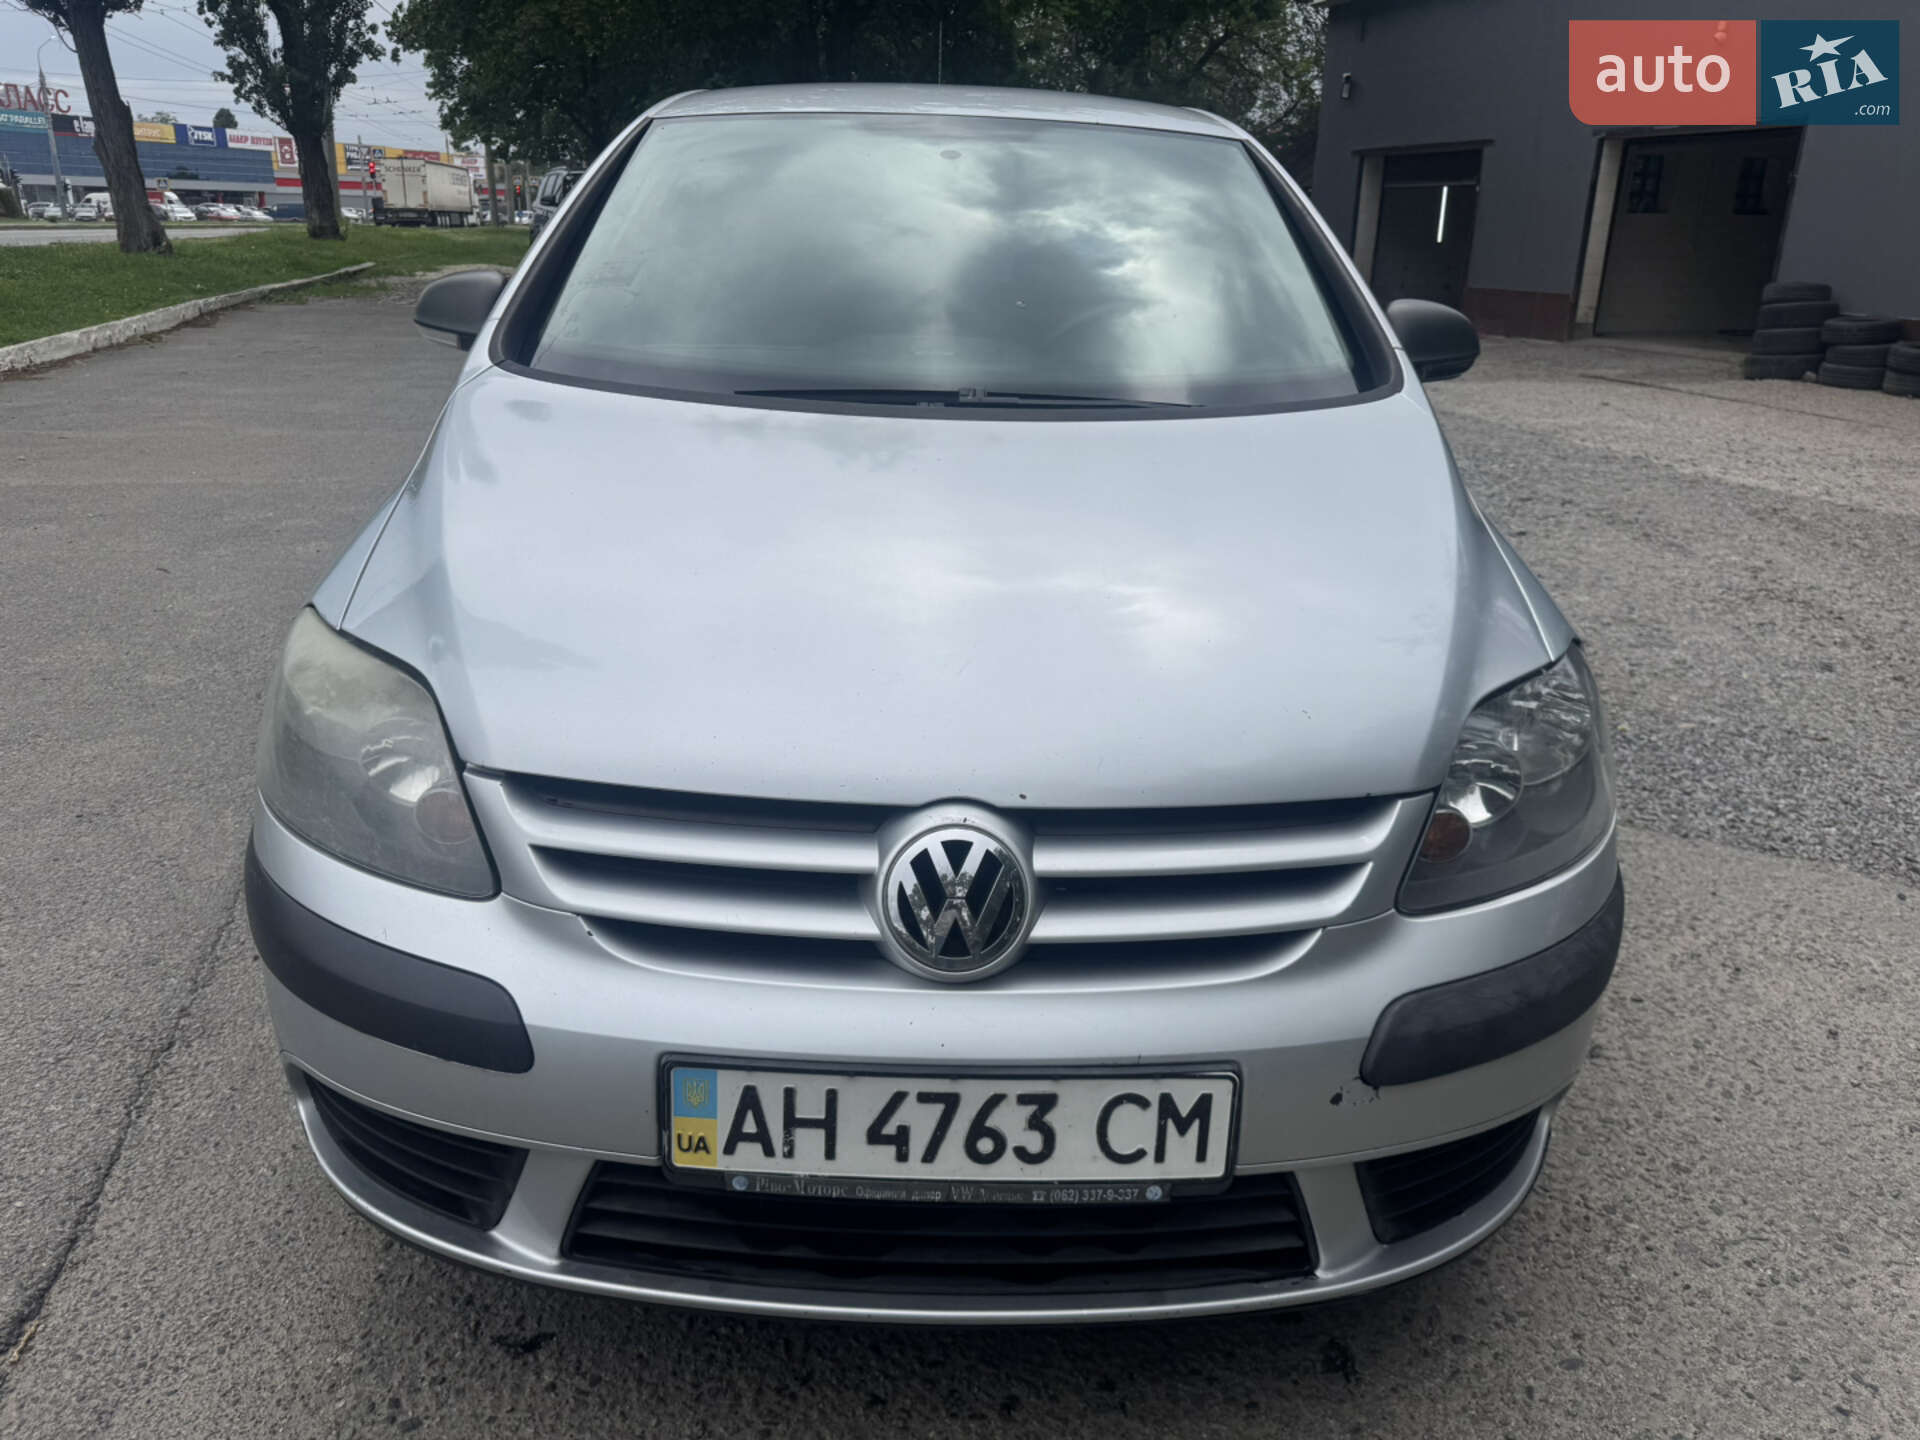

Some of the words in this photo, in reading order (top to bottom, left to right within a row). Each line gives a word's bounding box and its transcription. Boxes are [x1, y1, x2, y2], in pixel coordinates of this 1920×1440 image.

[0, 82, 72, 114] ЛАСС
[676, 1131, 712, 1155] UA
[866, 1090, 1060, 1165] 4763
